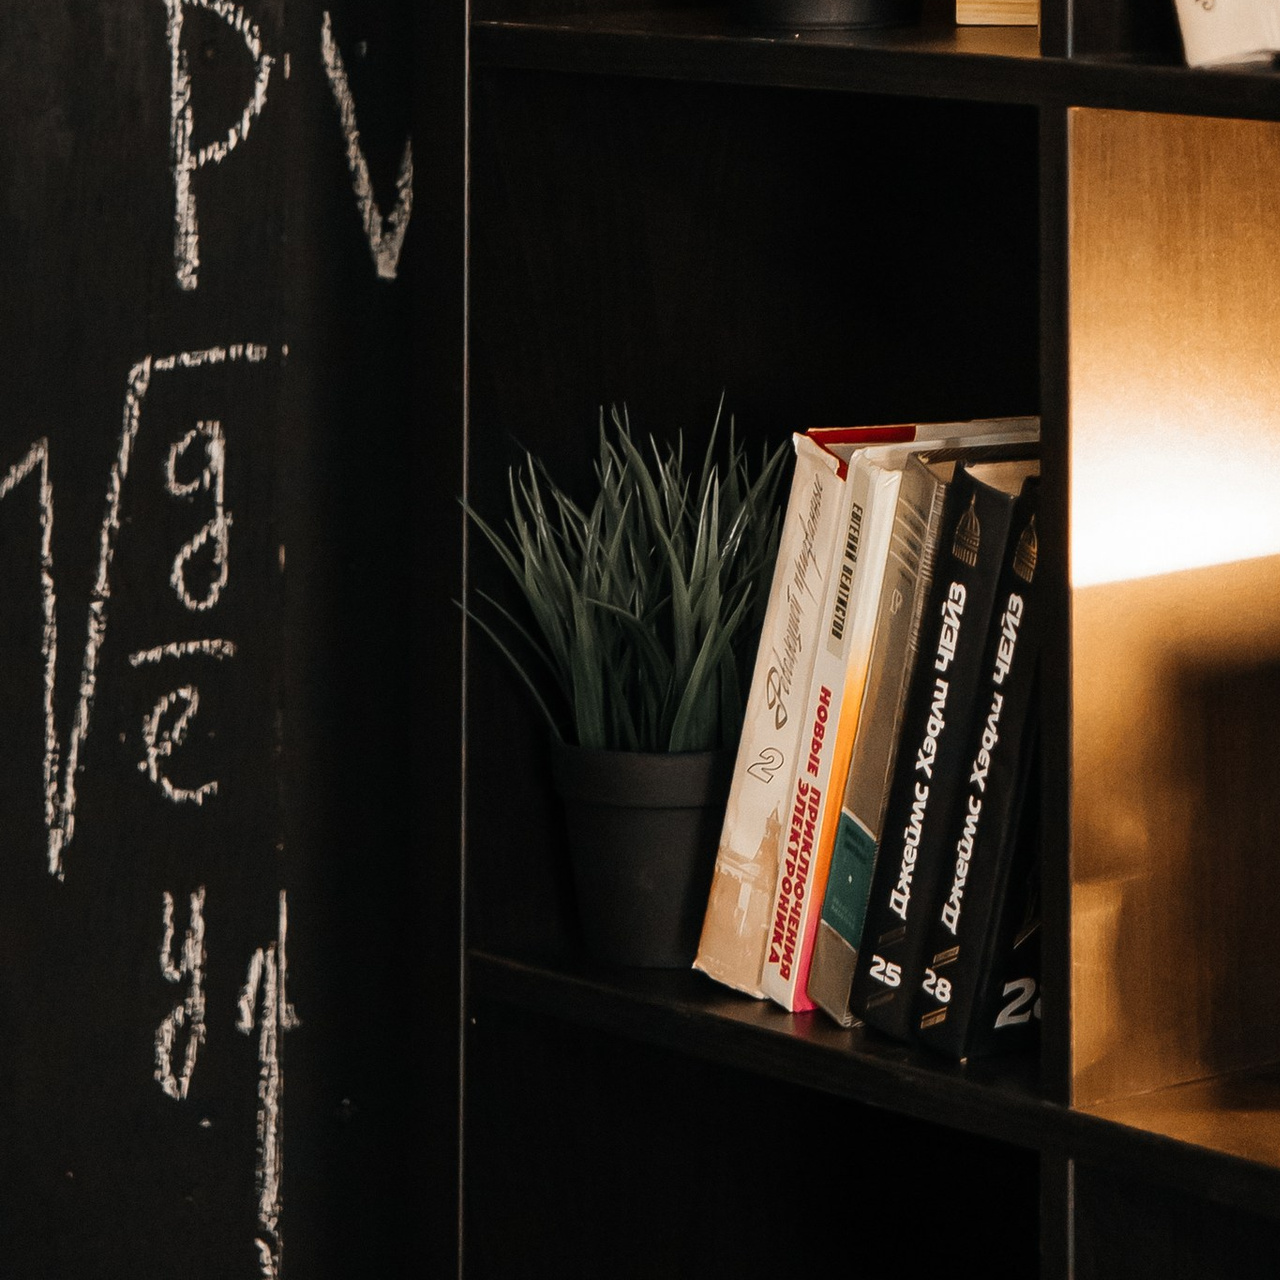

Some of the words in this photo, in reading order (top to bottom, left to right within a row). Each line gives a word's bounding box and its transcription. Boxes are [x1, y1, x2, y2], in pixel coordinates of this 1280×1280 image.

[844, 502, 863, 562] ЕВГЕНИЙ
[831, 564, 853, 640] ВЕЛТИСТОВ
[806, 685, 831, 777] НОВЫЕ
[767, 778, 809, 962] ЭЛЕКТРОНИКА
[778, 785, 821, 980] ПРИКЛЮЧЕНИЯ
[890, 781, 930, 920] Джеймс
[941, 794, 982, 935] Джеймс
[868, 954, 902, 989] 25
[921, 967, 952, 1004] 28
[994, 976, 1042, 1030] 2
